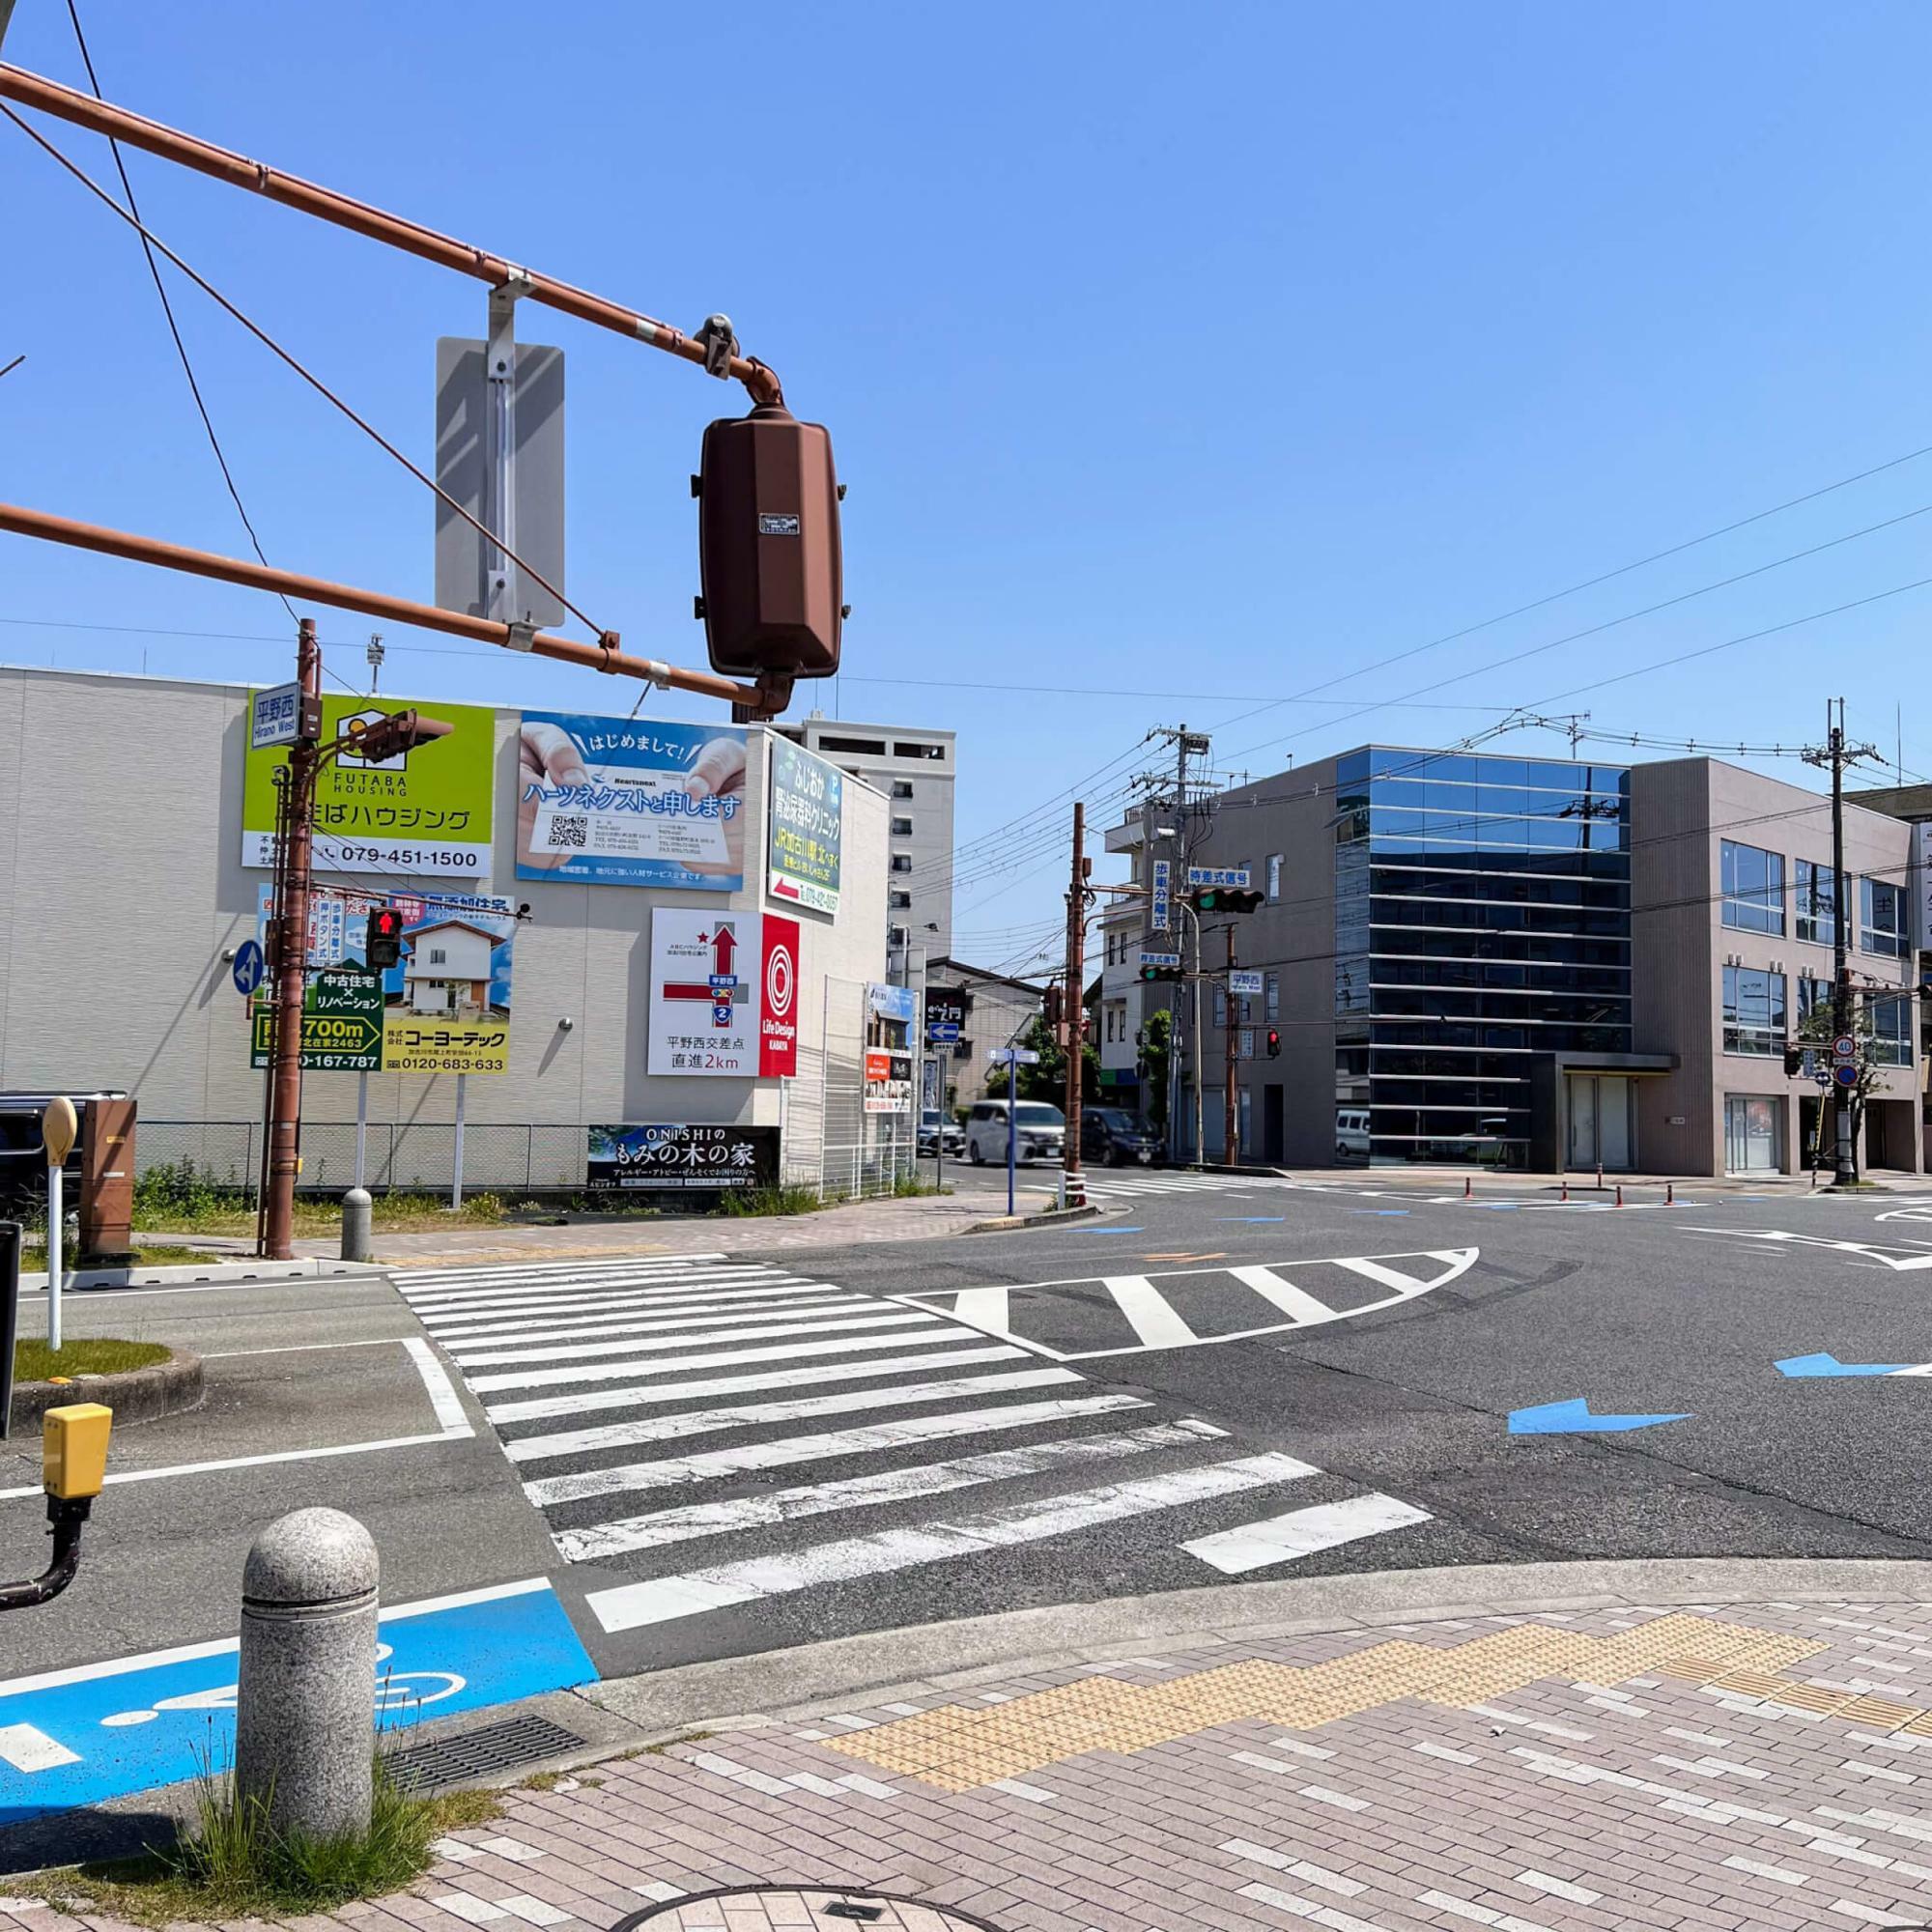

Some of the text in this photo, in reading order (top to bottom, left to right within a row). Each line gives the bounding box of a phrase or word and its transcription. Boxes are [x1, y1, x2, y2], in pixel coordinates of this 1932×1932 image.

[256, 694, 295, 724] 平野西
[254, 718, 296, 740] Hirano West
[589, 733, 685, 761] はじめまして!
[334, 772, 407, 788] FUTABA
[334, 785, 408, 797] HOUSING
[524, 782, 743, 821] ハーツネクストと申します
[341, 846, 478, 867] 079-451-1500
[1189, 869, 1247, 885] 時差式信号
[1153, 864, 1169, 927] 歩車分離式
[324, 974, 375, 988] 中古住宅
[317, 995, 380, 1010] リノベーション
[718, 1008, 727, 1018] 2
[405, 1030, 505, 1048] コーヨーテック
[668, 1036, 745, 1050] 平野西交差点
[1838, 1041, 1851, 1052] 40
[403, 1057, 503, 1070] 0120-683-633
[671, 1053, 739, 1069] 直進2km
[645, 1128, 725, 1141] ONISHIの
[616, 1142, 756, 1167] もみの木の家
